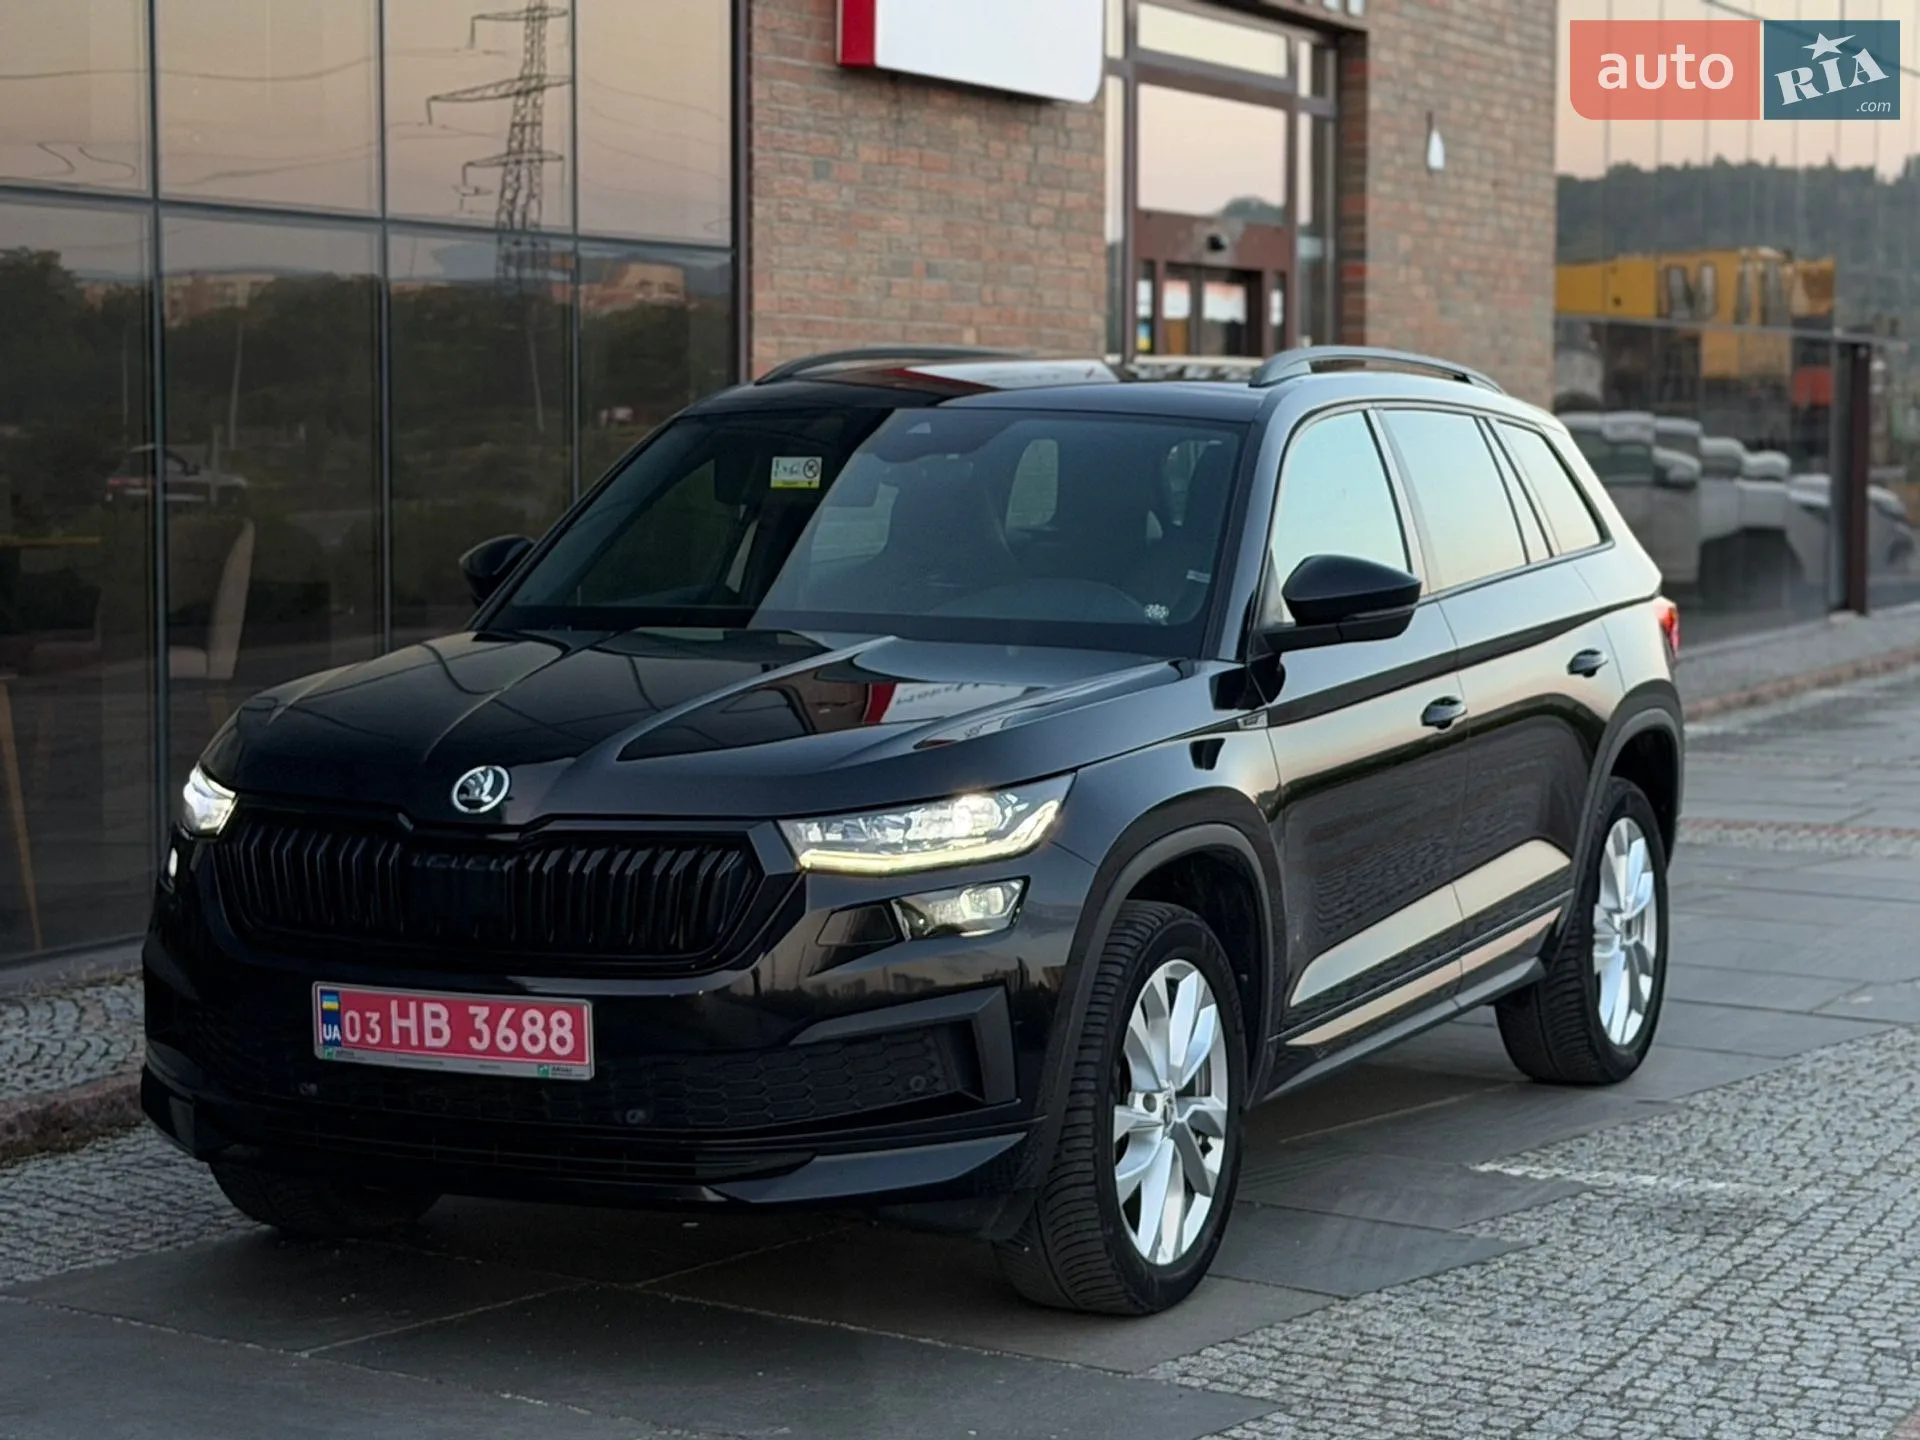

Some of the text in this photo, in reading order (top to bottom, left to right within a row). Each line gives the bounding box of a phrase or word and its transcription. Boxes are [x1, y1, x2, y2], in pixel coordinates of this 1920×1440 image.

[322, 1023, 341, 1041] UA
[344, 1000, 575, 1056] 03 HB 3688
